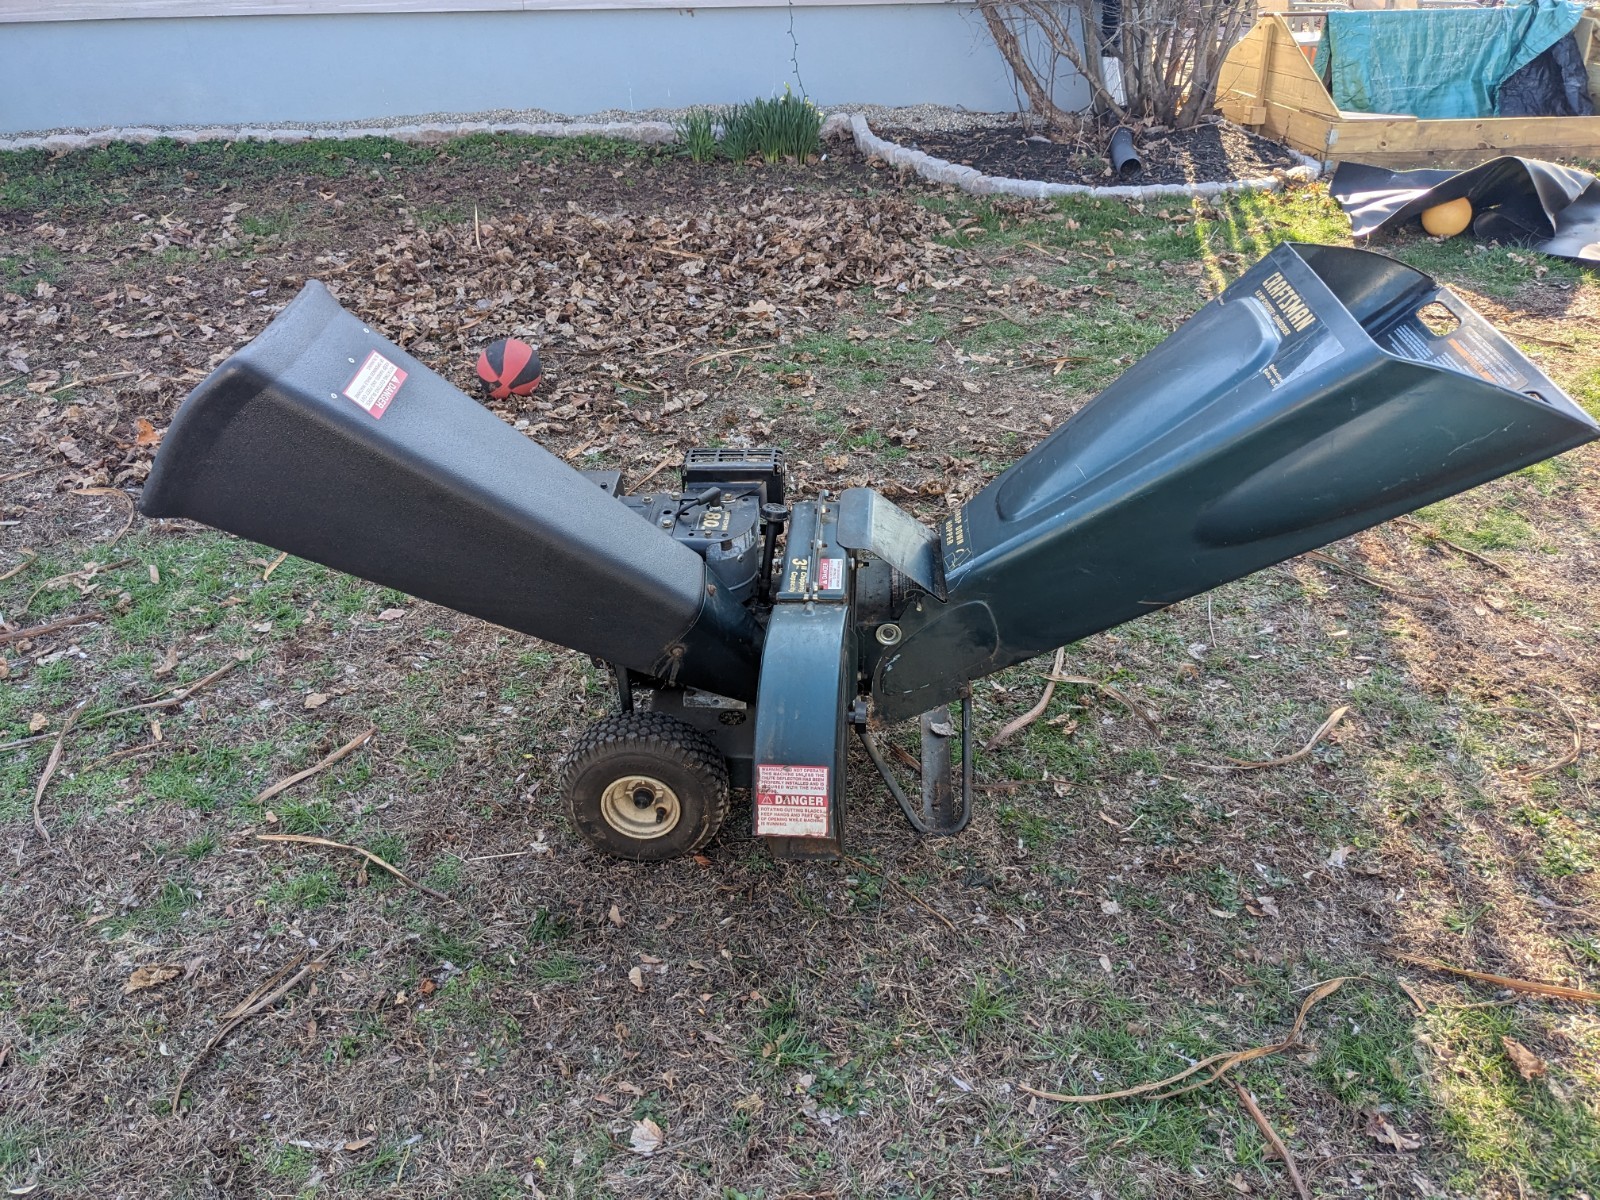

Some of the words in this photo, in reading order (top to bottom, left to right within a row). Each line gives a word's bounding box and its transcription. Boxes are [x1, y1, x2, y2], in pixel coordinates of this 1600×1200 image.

[1262, 272, 1316, 332] CRAFTSMAN
[1272, 314, 1290, 336] SHREDDER
[375, 382, 397, 408] DANGER
[946, 520, 954, 546] HOPPER
[956, 525, 964, 545] DOWN
[788, 572, 798, 592] Capacity
[798, 572, 807, 592] Chipping
[775, 796, 823, 806] DANGER
